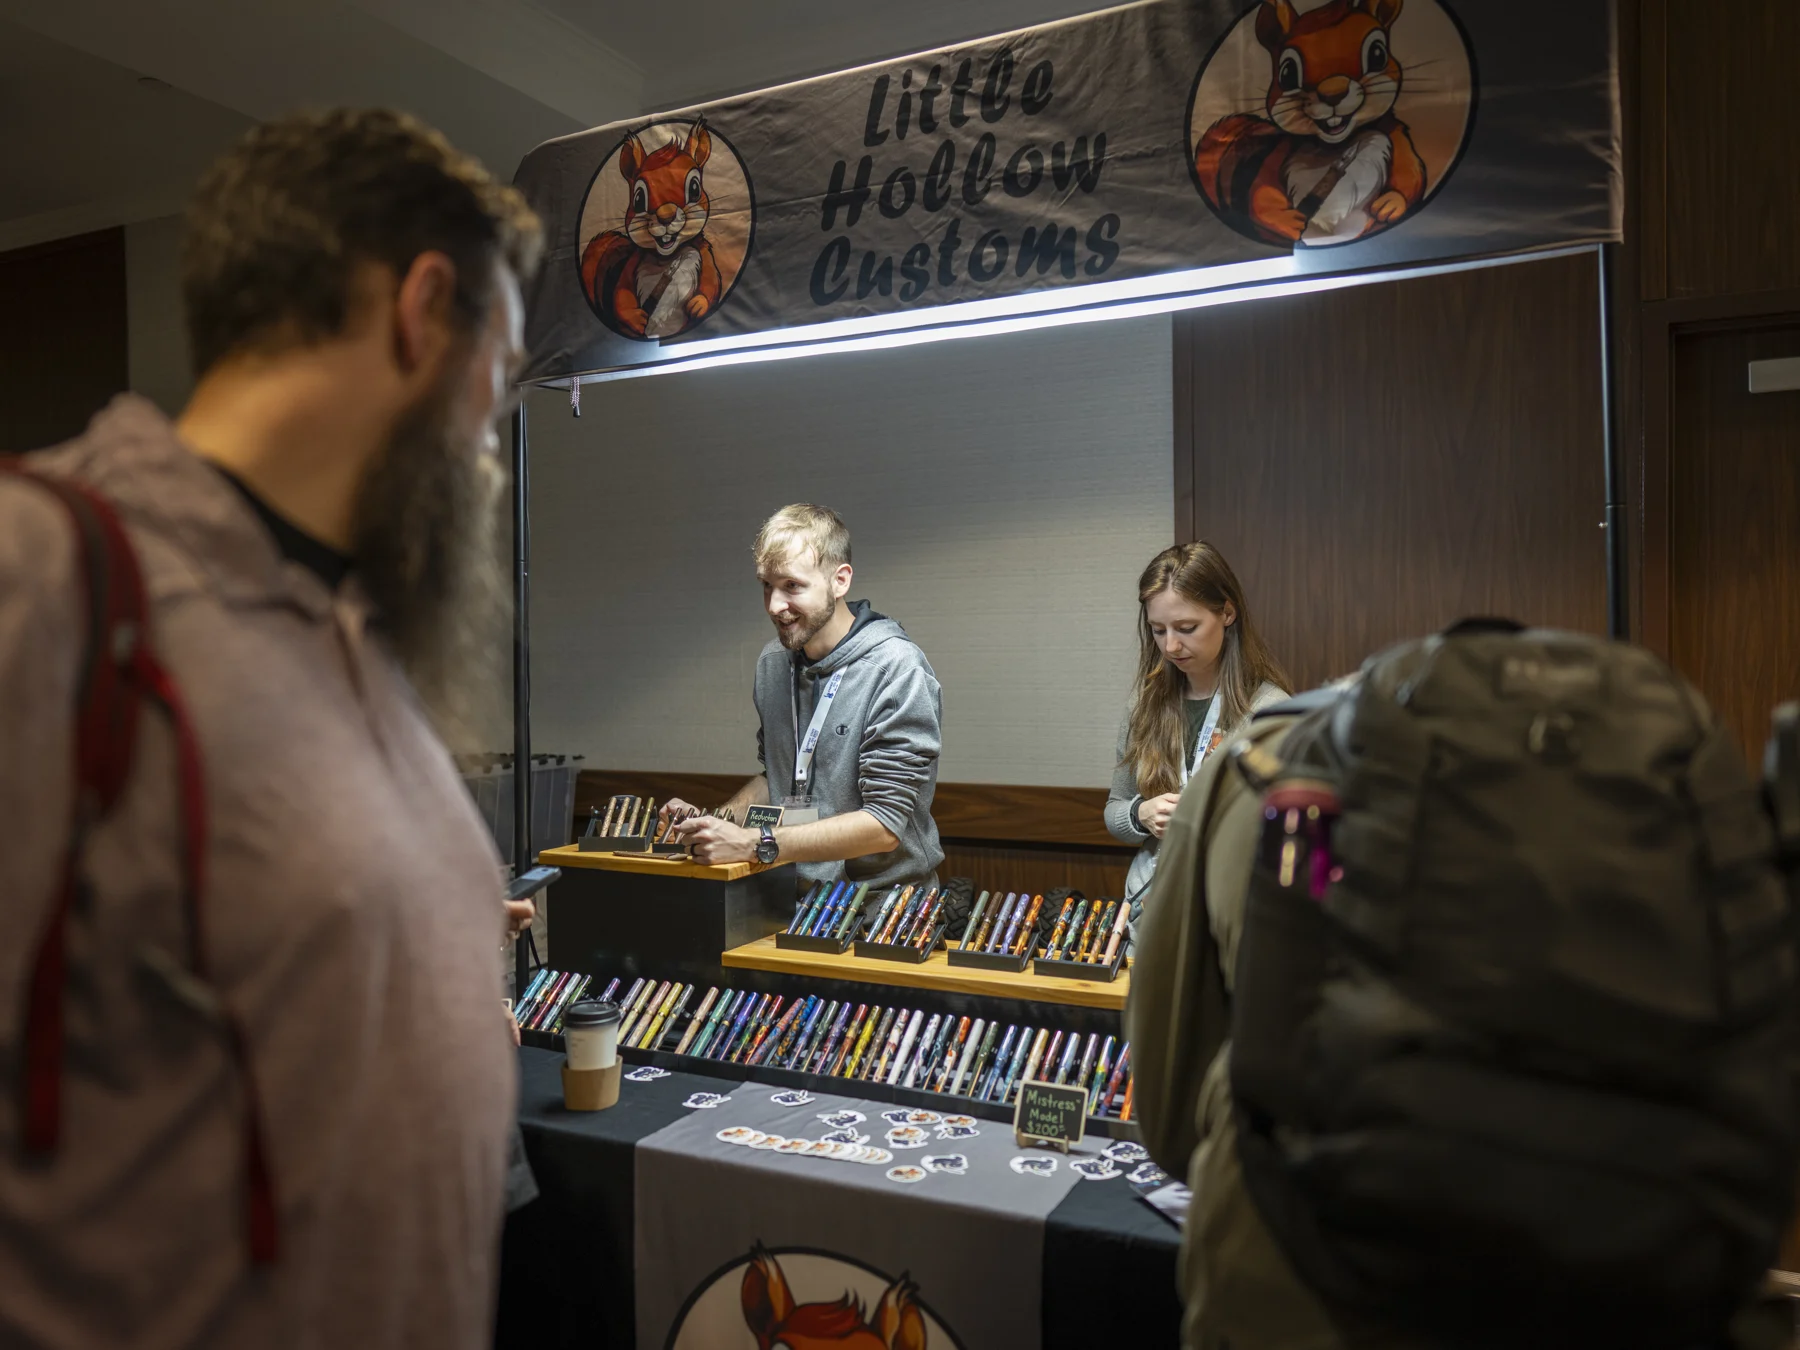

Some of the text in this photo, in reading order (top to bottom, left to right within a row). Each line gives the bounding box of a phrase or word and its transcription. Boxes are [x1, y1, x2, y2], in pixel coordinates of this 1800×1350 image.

[864, 48, 1053, 147] Little
[820, 132, 1107, 230] Hollow
[809, 213, 1121, 305] Customs
[1030, 1108, 1063, 1124] Model
